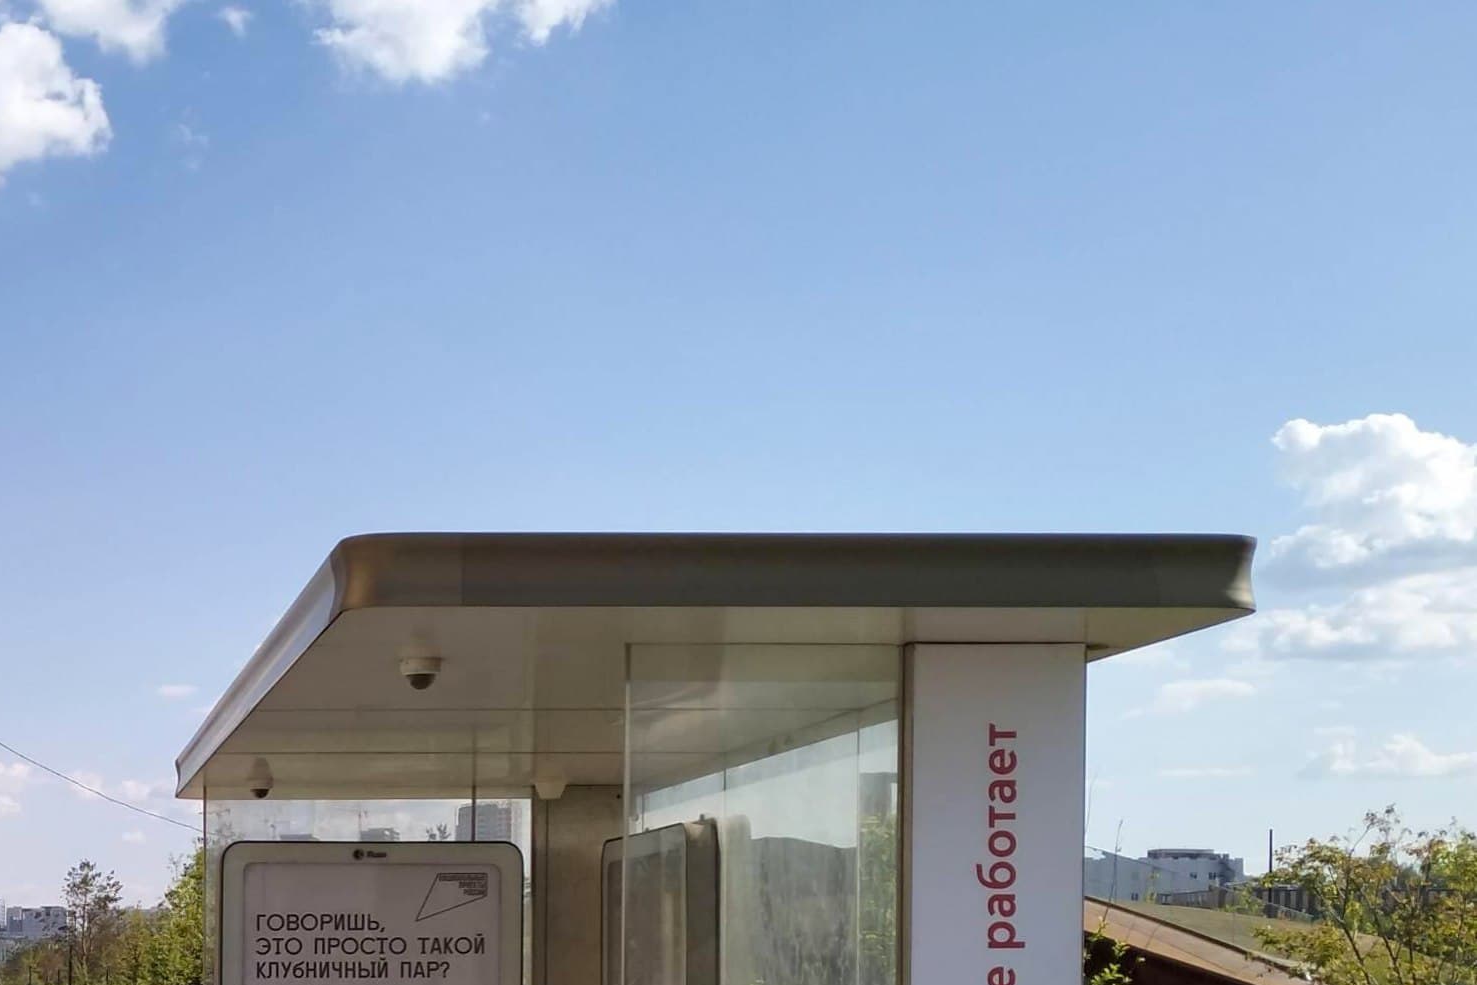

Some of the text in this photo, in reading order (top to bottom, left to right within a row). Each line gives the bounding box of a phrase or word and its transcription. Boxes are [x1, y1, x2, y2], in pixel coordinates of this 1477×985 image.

[975, 722, 1025, 949] работает
[256, 913, 386, 933] ГОВОРИШЬ,
[255, 933, 485, 955] ЭТО ПРОСТО ТАКОЙ
[400, 960, 450, 979] ПАР?
